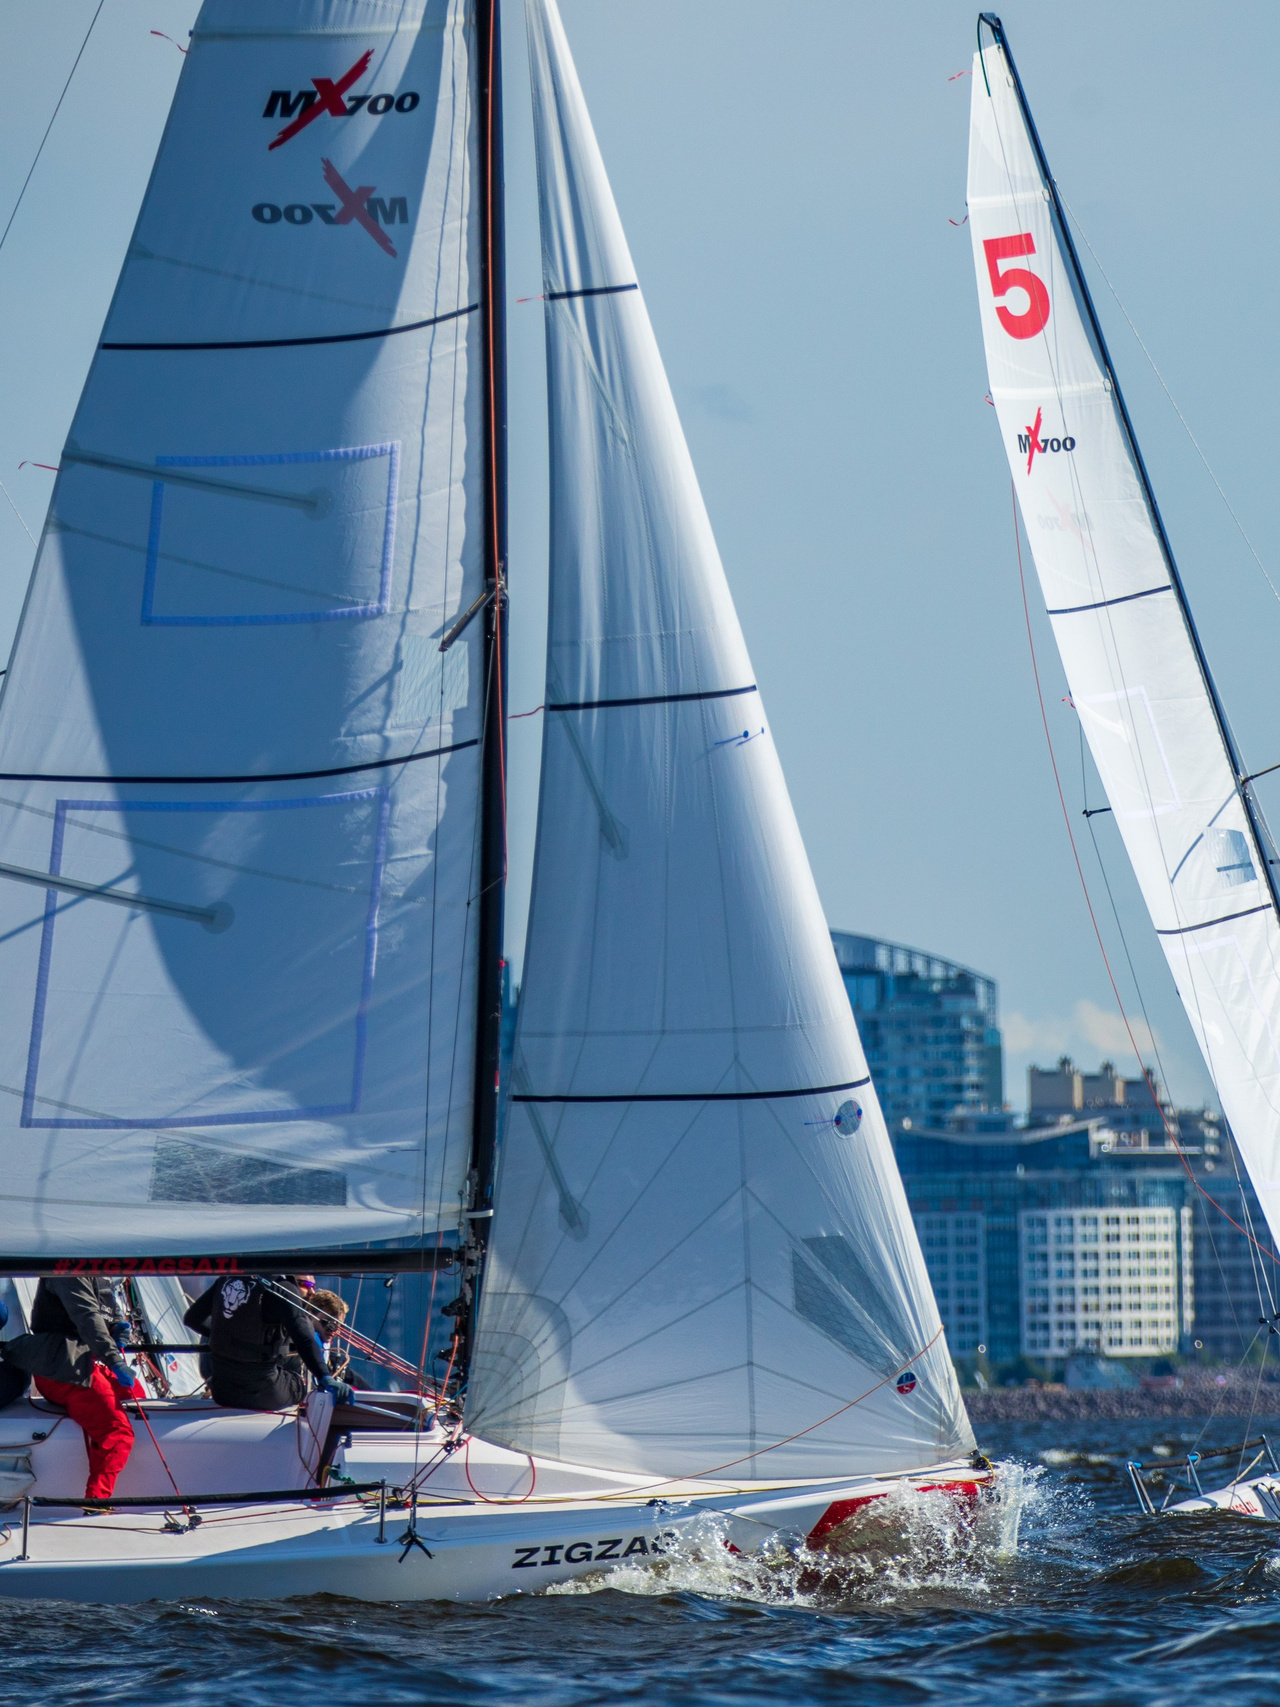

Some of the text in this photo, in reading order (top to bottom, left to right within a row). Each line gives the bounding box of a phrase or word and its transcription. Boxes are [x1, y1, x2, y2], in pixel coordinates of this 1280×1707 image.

[262, 48, 420, 151] MX700
[982, 232, 1051, 340] 5
[1017, 405, 1076, 476] MX700
[53, 1257, 245, 1275] #ZIGZAGSAIL
